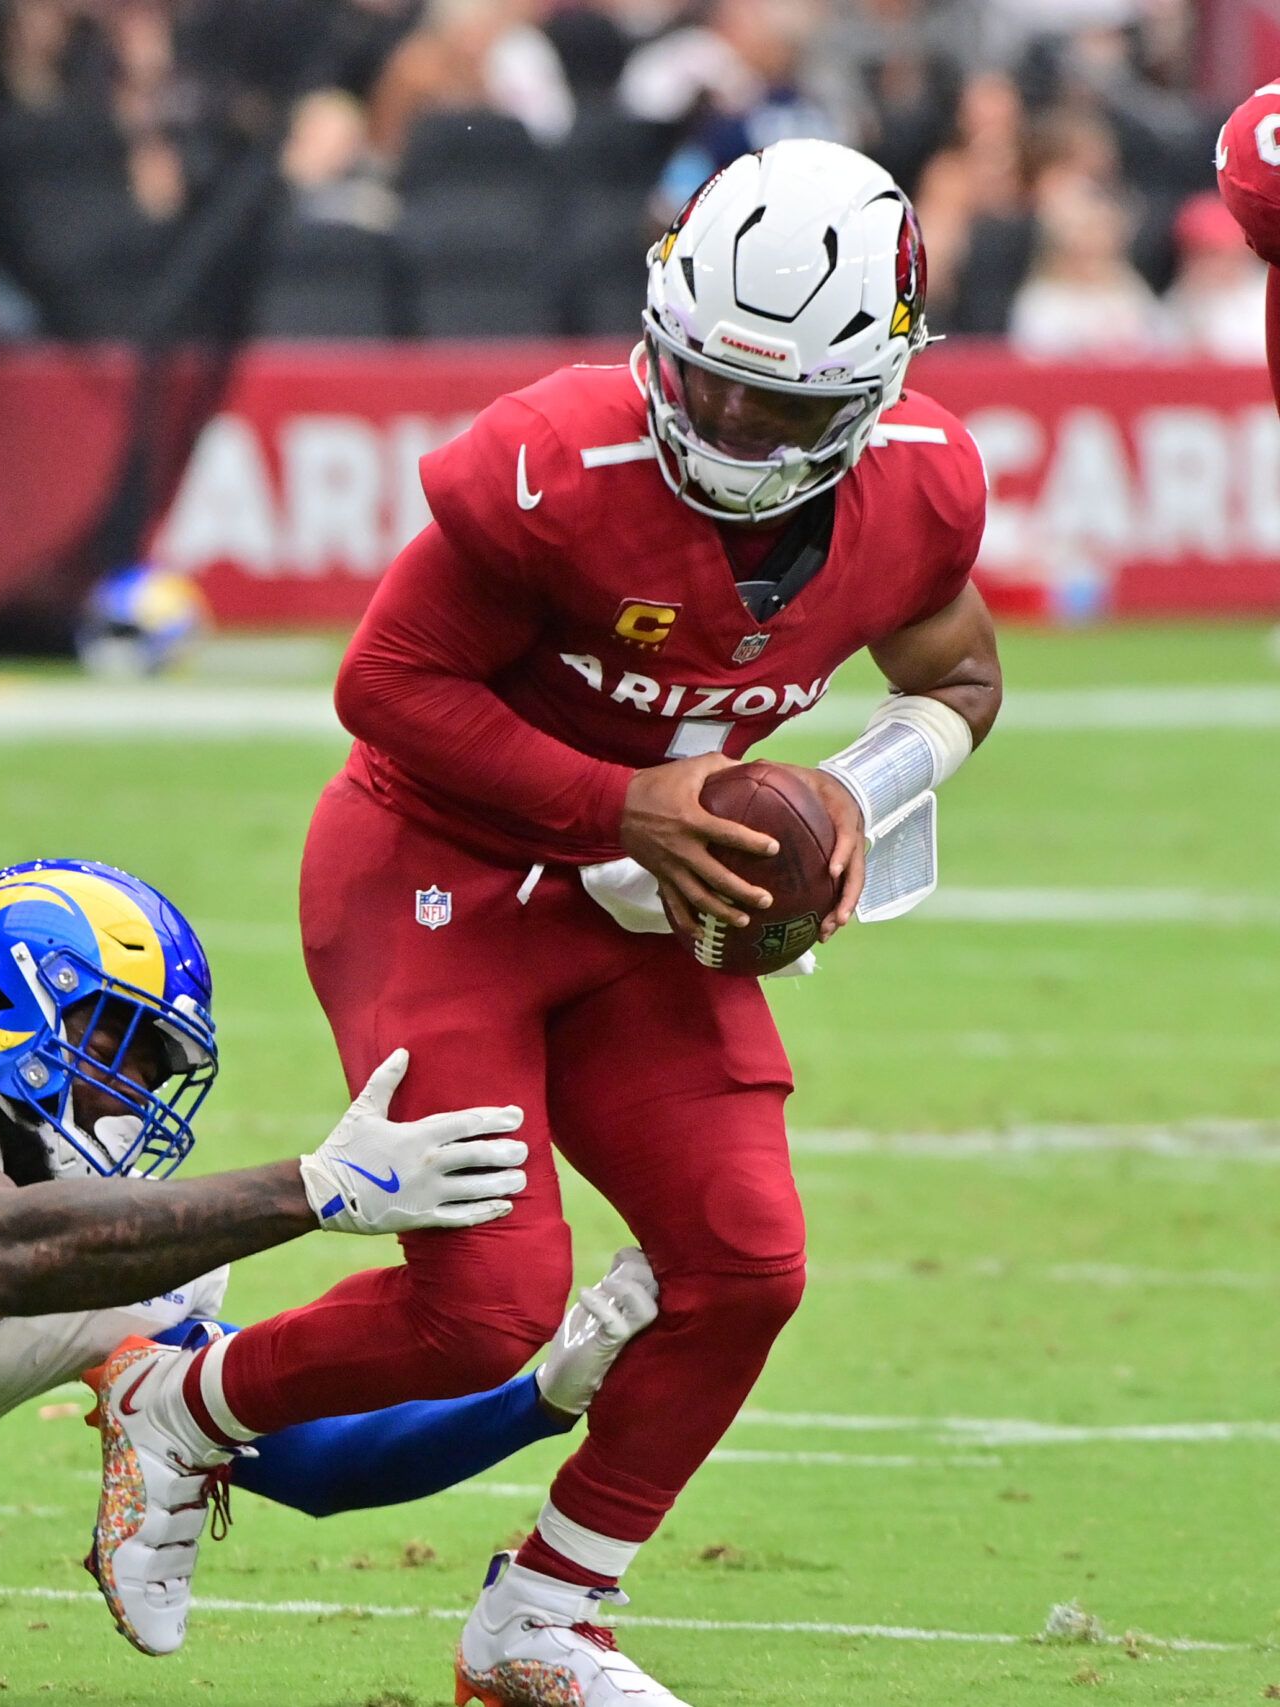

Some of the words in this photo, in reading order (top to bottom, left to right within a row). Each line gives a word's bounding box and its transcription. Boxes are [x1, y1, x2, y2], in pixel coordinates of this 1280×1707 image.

[721, 336, 786, 361] CARDINALS
[161, 411, 475, 577] ARI
[615, 604, 676, 643] C
[560, 653, 832, 717] ARIZON
